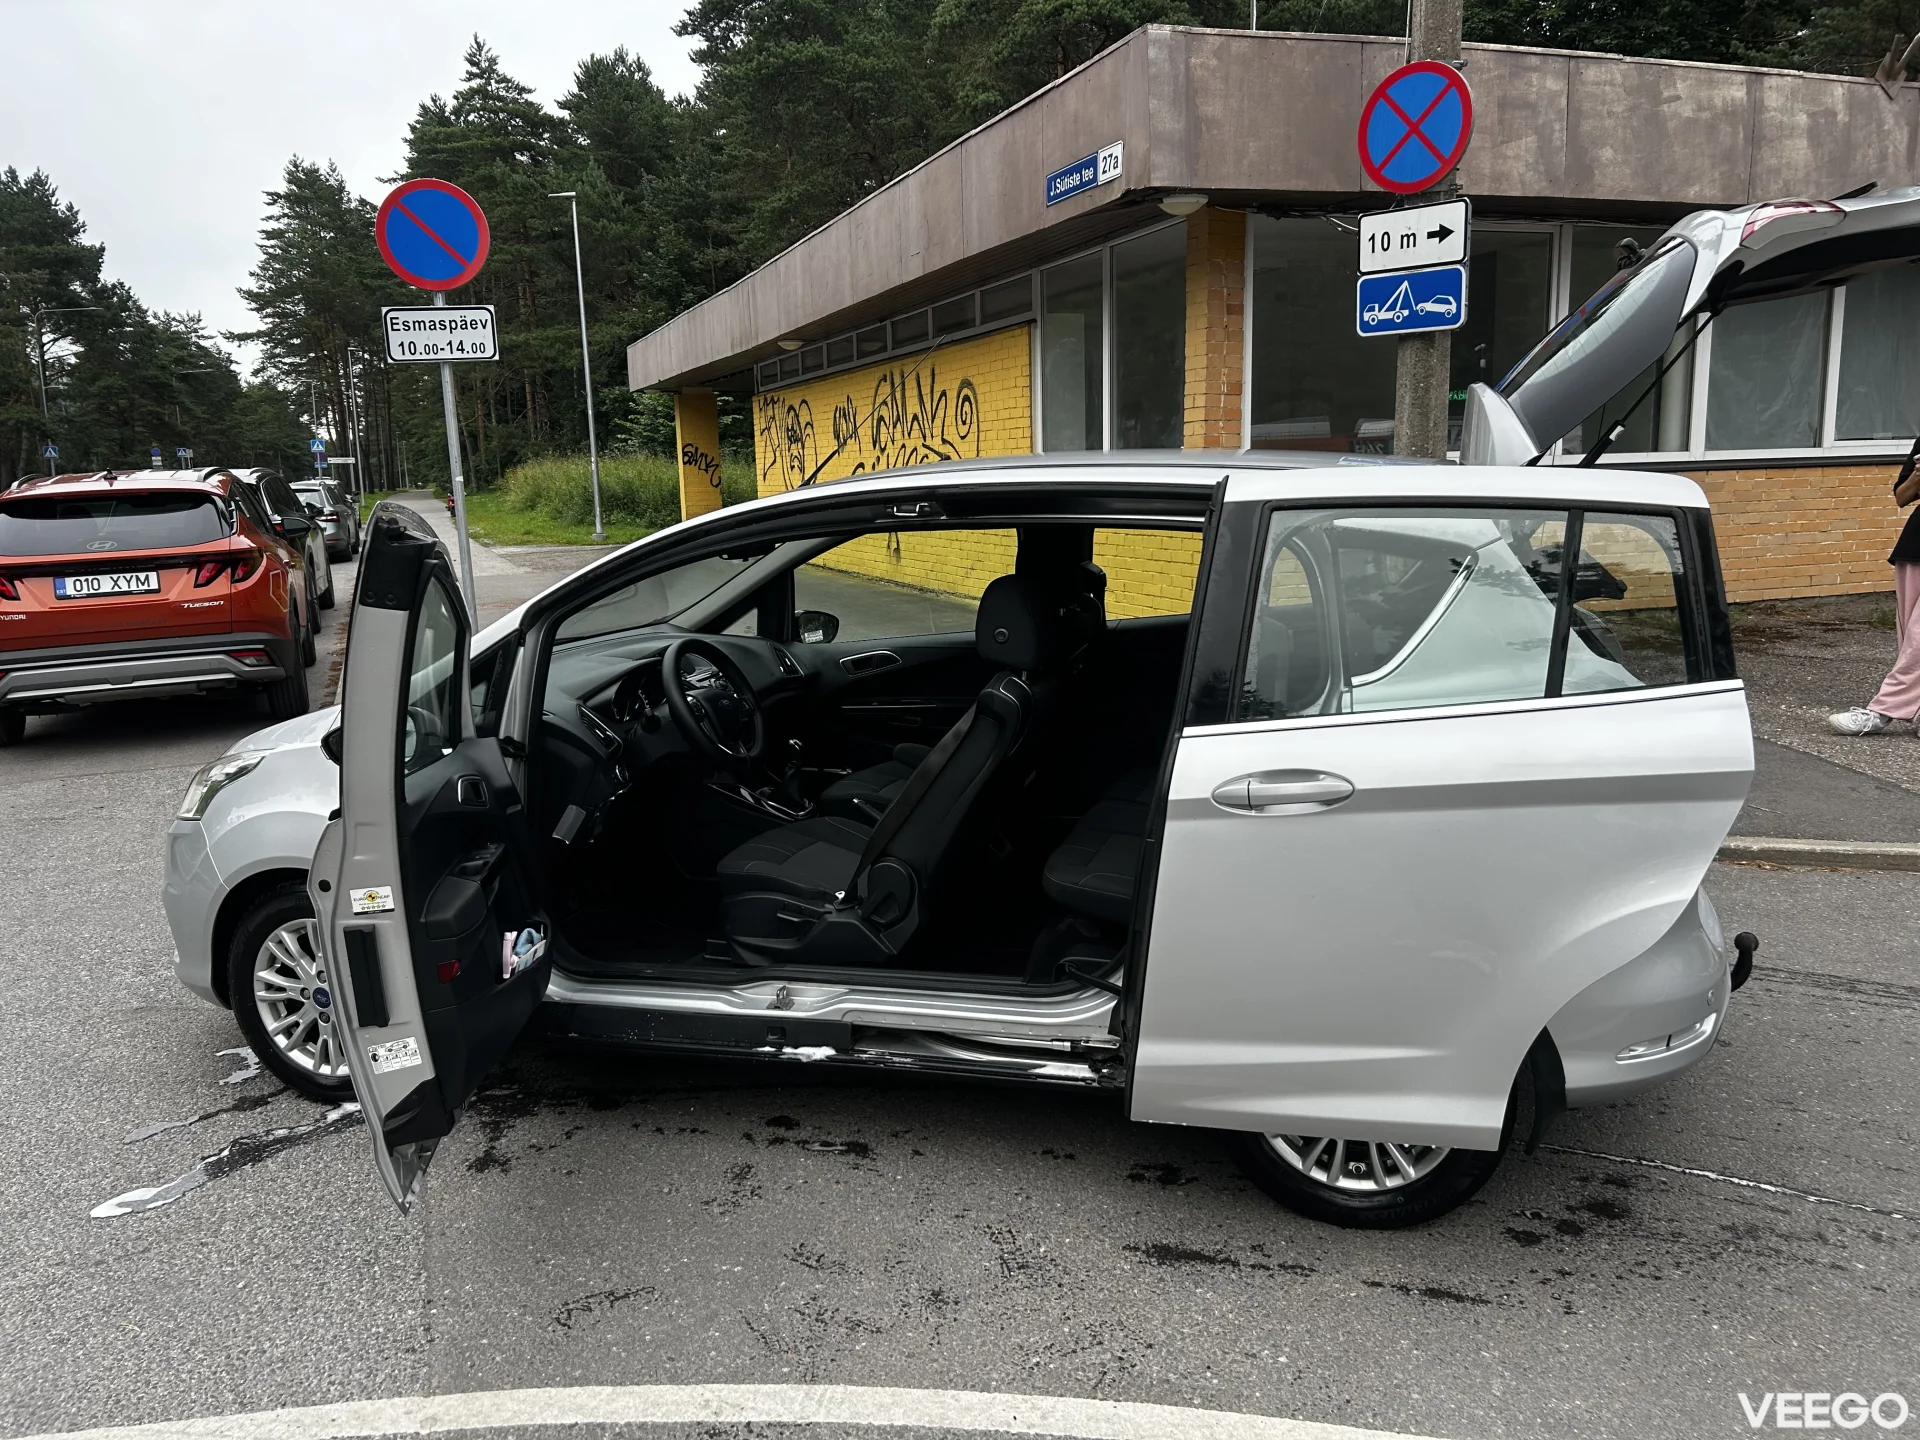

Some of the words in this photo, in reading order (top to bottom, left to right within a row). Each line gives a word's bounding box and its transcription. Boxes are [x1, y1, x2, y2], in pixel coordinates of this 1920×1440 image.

[1101, 152, 1119, 175] 27a
[1082, 166, 1094, 183] tee
[1368, 231, 1391, 254] 10
[1400, 232, 1417, 249] m
[389, 315, 489, 334] Esmaspäev
[398, 339, 486, 356] 10.00-14.00
[73, 577, 101, 593] 010
[109, 573, 151, 591] XYM
[181, 600, 224, 609] TUCSON
